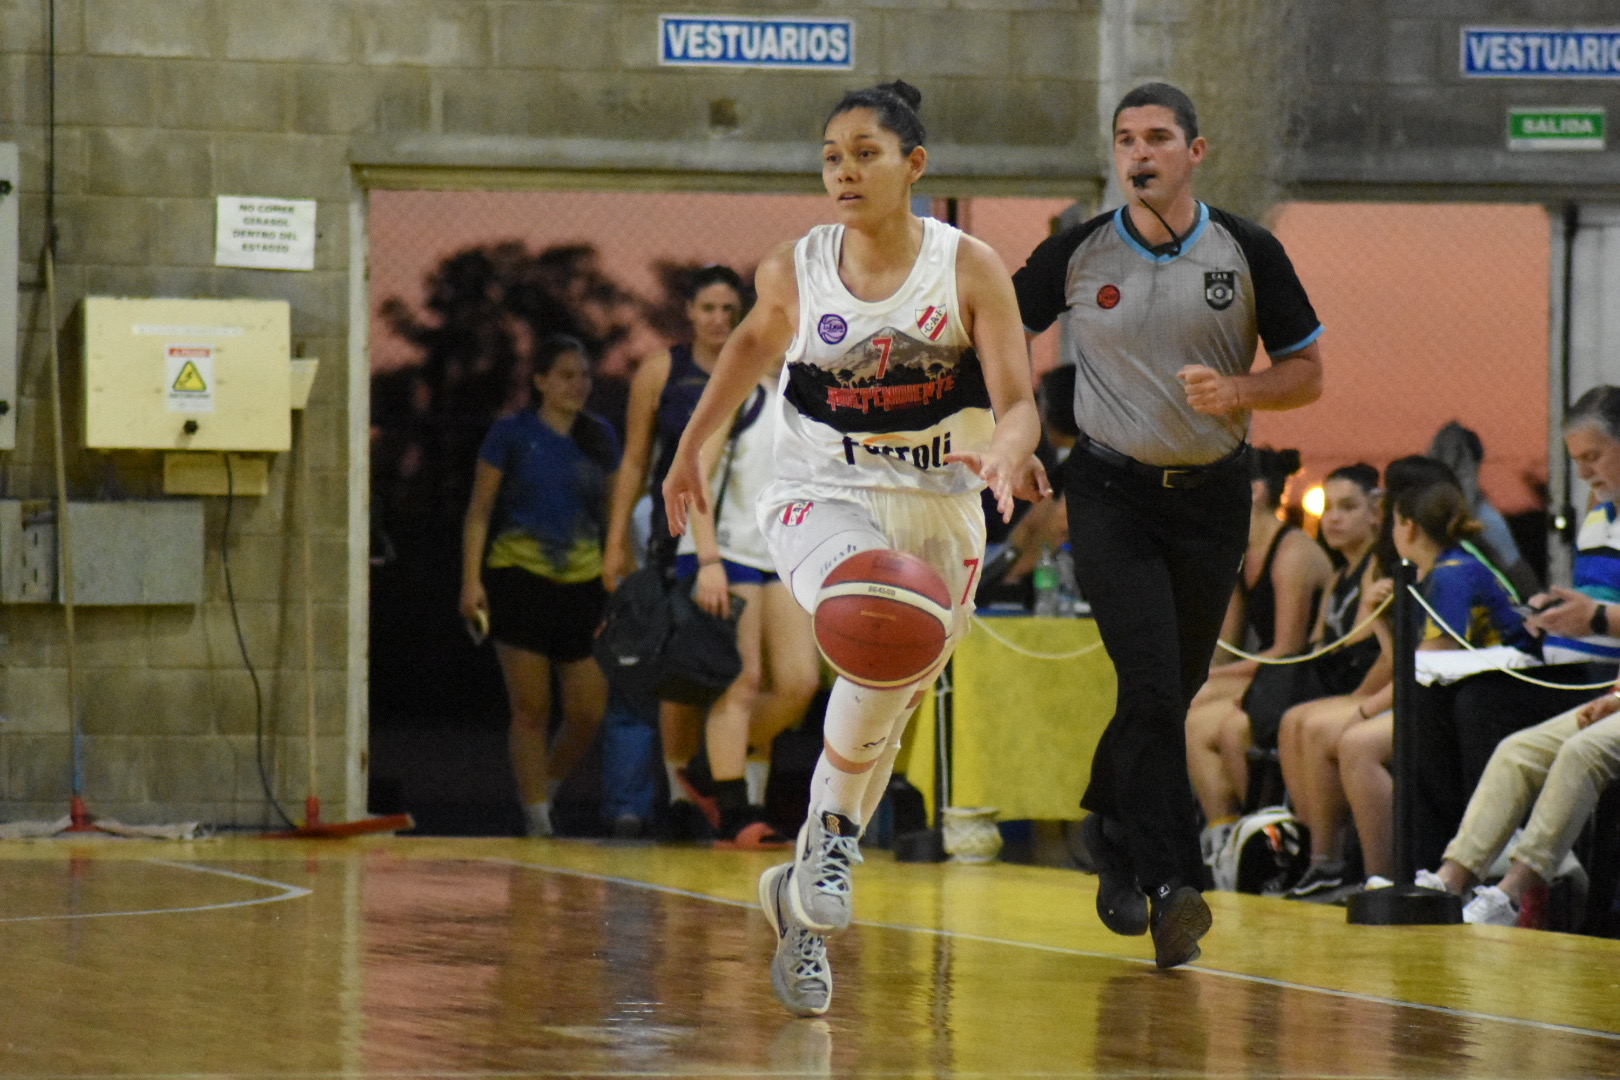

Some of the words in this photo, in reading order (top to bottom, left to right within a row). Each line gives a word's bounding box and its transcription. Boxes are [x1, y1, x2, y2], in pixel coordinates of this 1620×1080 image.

[667, 23, 847, 61] VESTUARIOS
[1522, 118, 1593, 133] SALIDA
[239, 204, 255, 212] NO
[232, 229, 276, 239] DENTRO
[279, 231, 297, 240] DEL
[242, 243, 289, 253] ESTADIO
[873, 338, 892, 379] 7
[961, 558, 979, 606] 7
